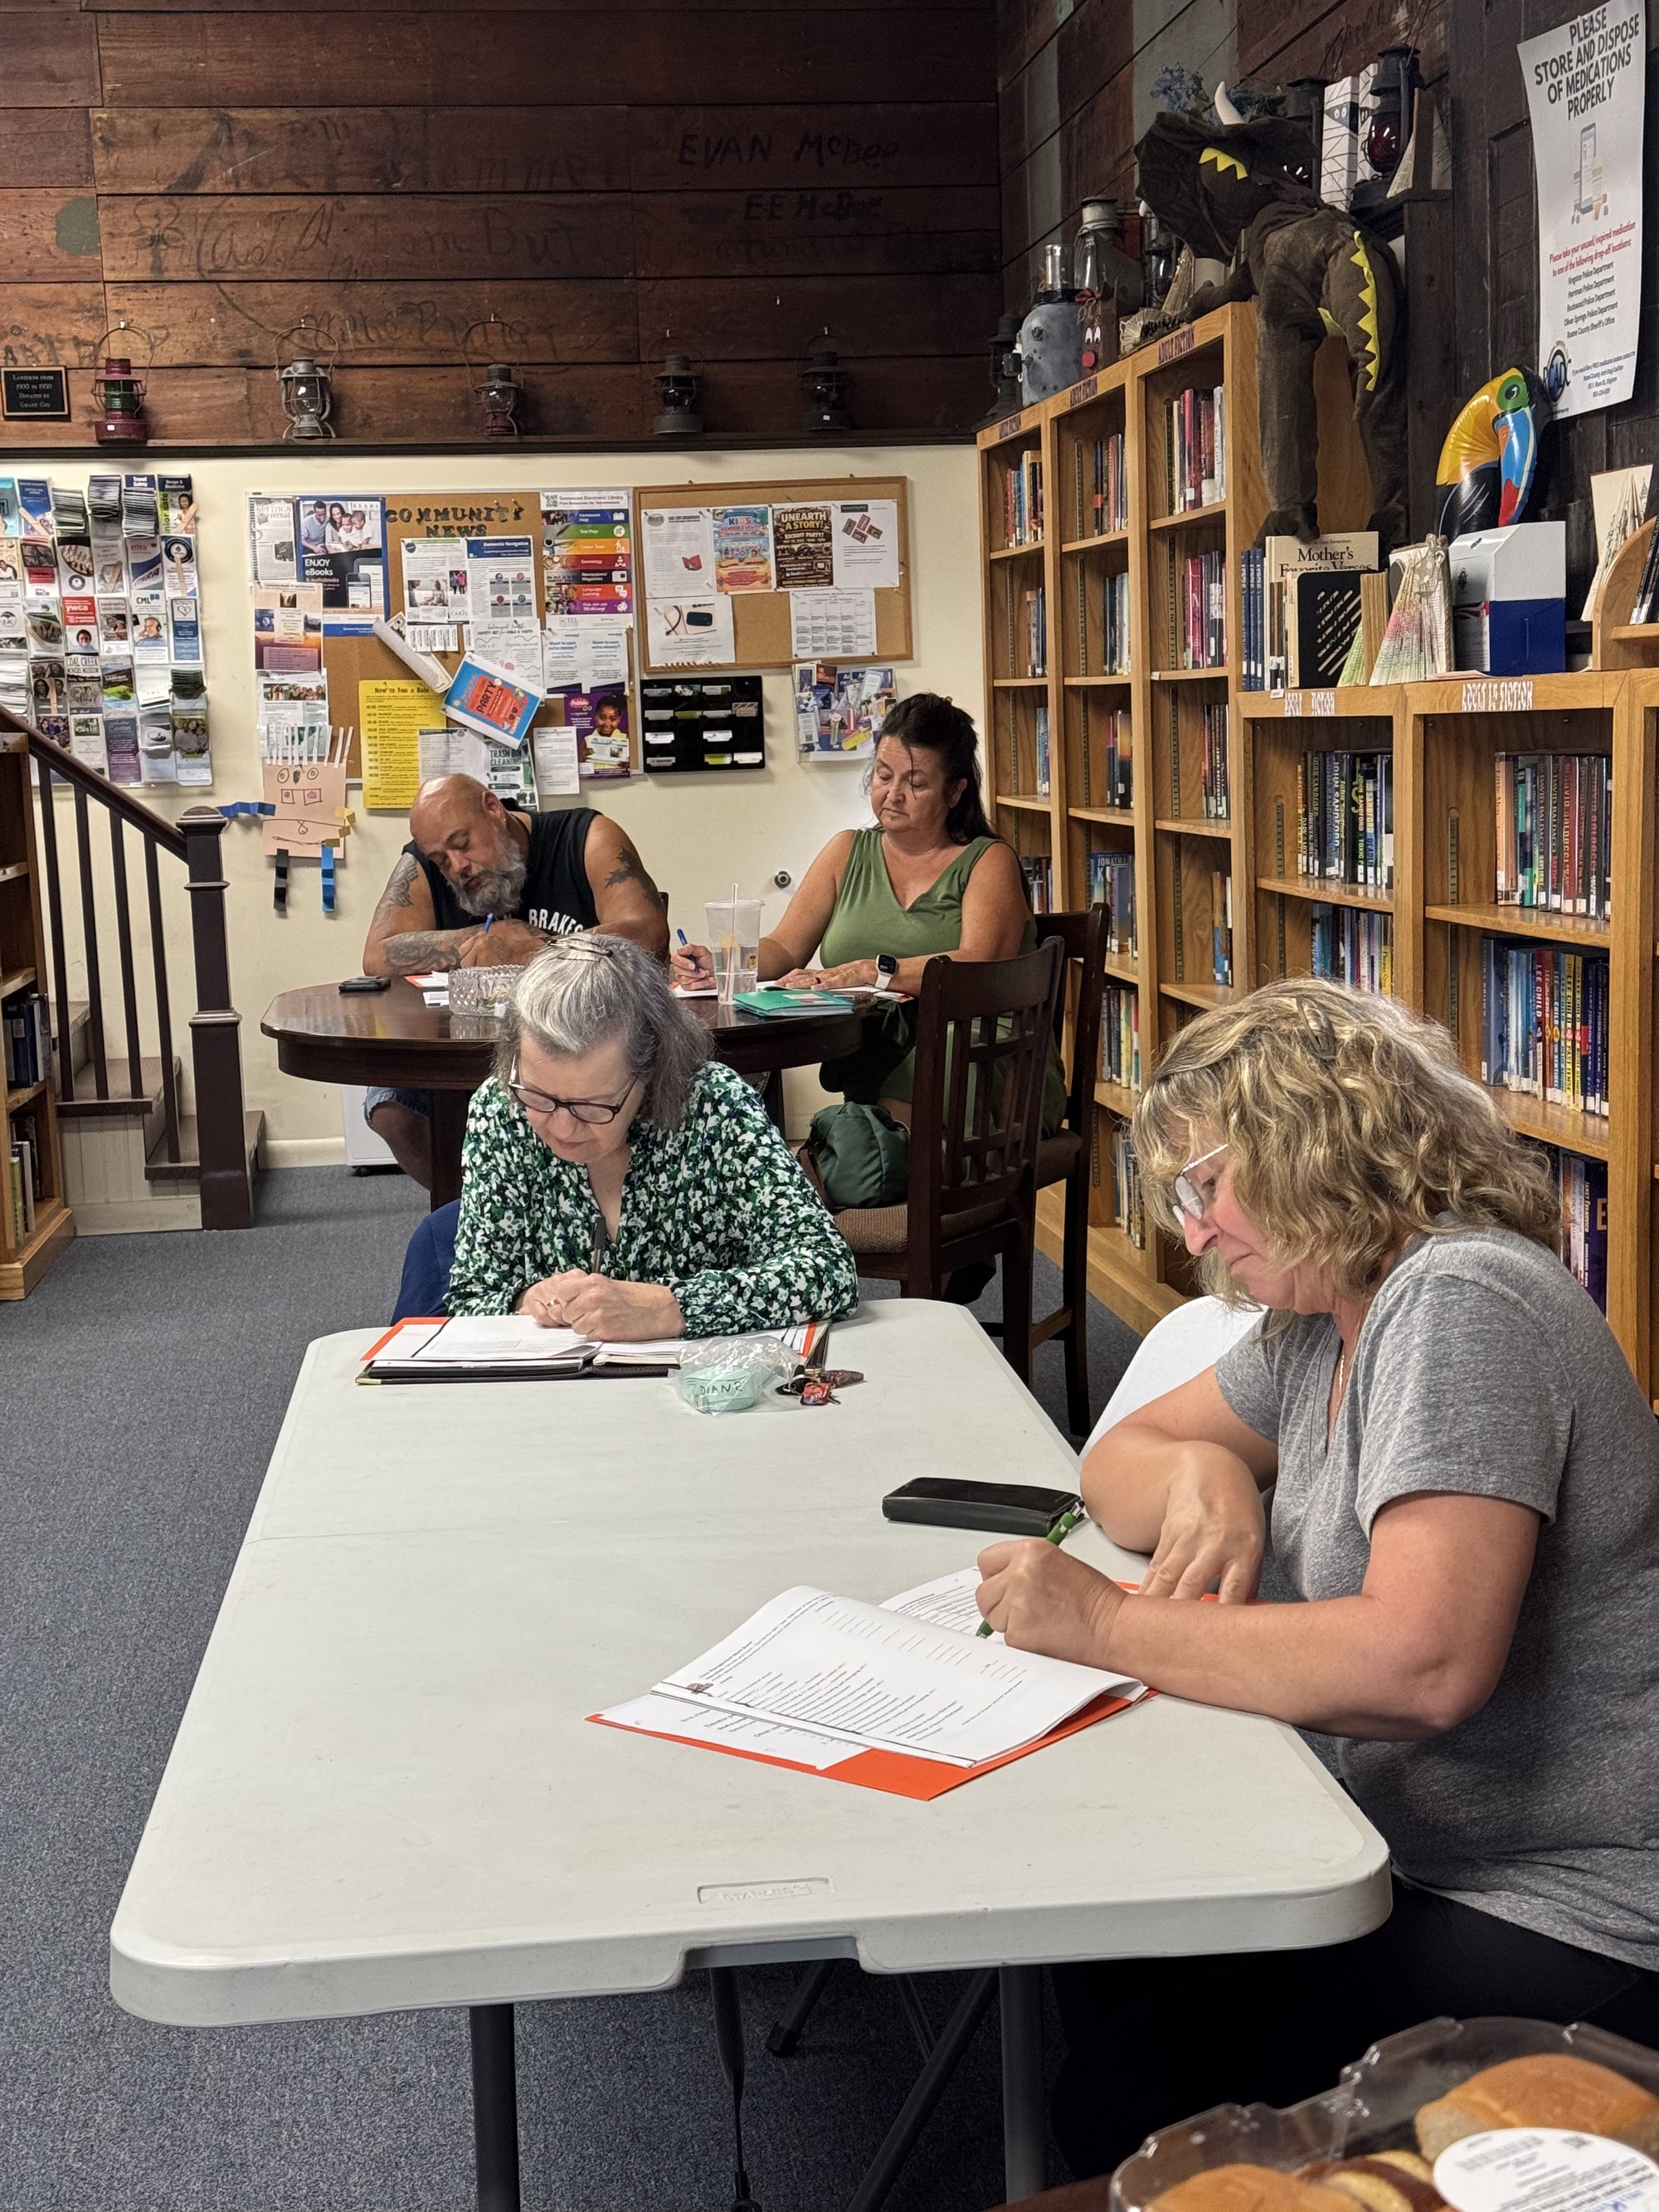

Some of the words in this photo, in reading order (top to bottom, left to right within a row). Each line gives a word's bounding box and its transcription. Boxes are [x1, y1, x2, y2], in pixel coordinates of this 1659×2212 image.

[1569, 7, 1607, 46] PLEASE
[1535, 51, 1574, 85] STORE
[1575, 39, 1595, 69] AND
[1597, 12, 1640, 56] DISPOSE
[1547, 80, 1563, 105] OF
[1565, 42, 1632, 98] MEDICATIONS
[1567, 76, 1615, 121] PROPERLY
[679, 134, 774, 169] EVAN
[385, 506, 524, 524] COMMUNITY
[728, 517, 751, 525] KIDS
[781, 511, 827, 523] UNEARTH
[426, 524, 488, 538] NEWS
[785, 523, 792, 531] A
[793, 521, 824, 529] STORY!
[304, 558, 331, 567] ENJOY
[1297, 546, 1355, 563] Mother's
[304, 568, 333, 576] eBooks
[66, 604, 89, 612] ywca
[475, 680, 497, 714] PARTY
[1462, 682, 1487, 712] ADULT
[1500, 680, 1533, 711] FICTION
[489, 749, 510, 758] TRASH
[490, 758, 521, 767] CLEANING
[1366, 792, 1374, 833] SANDFORD
[1097, 855, 1130, 867] JONATHA
[1366, 838, 1374, 868] DEADLI
